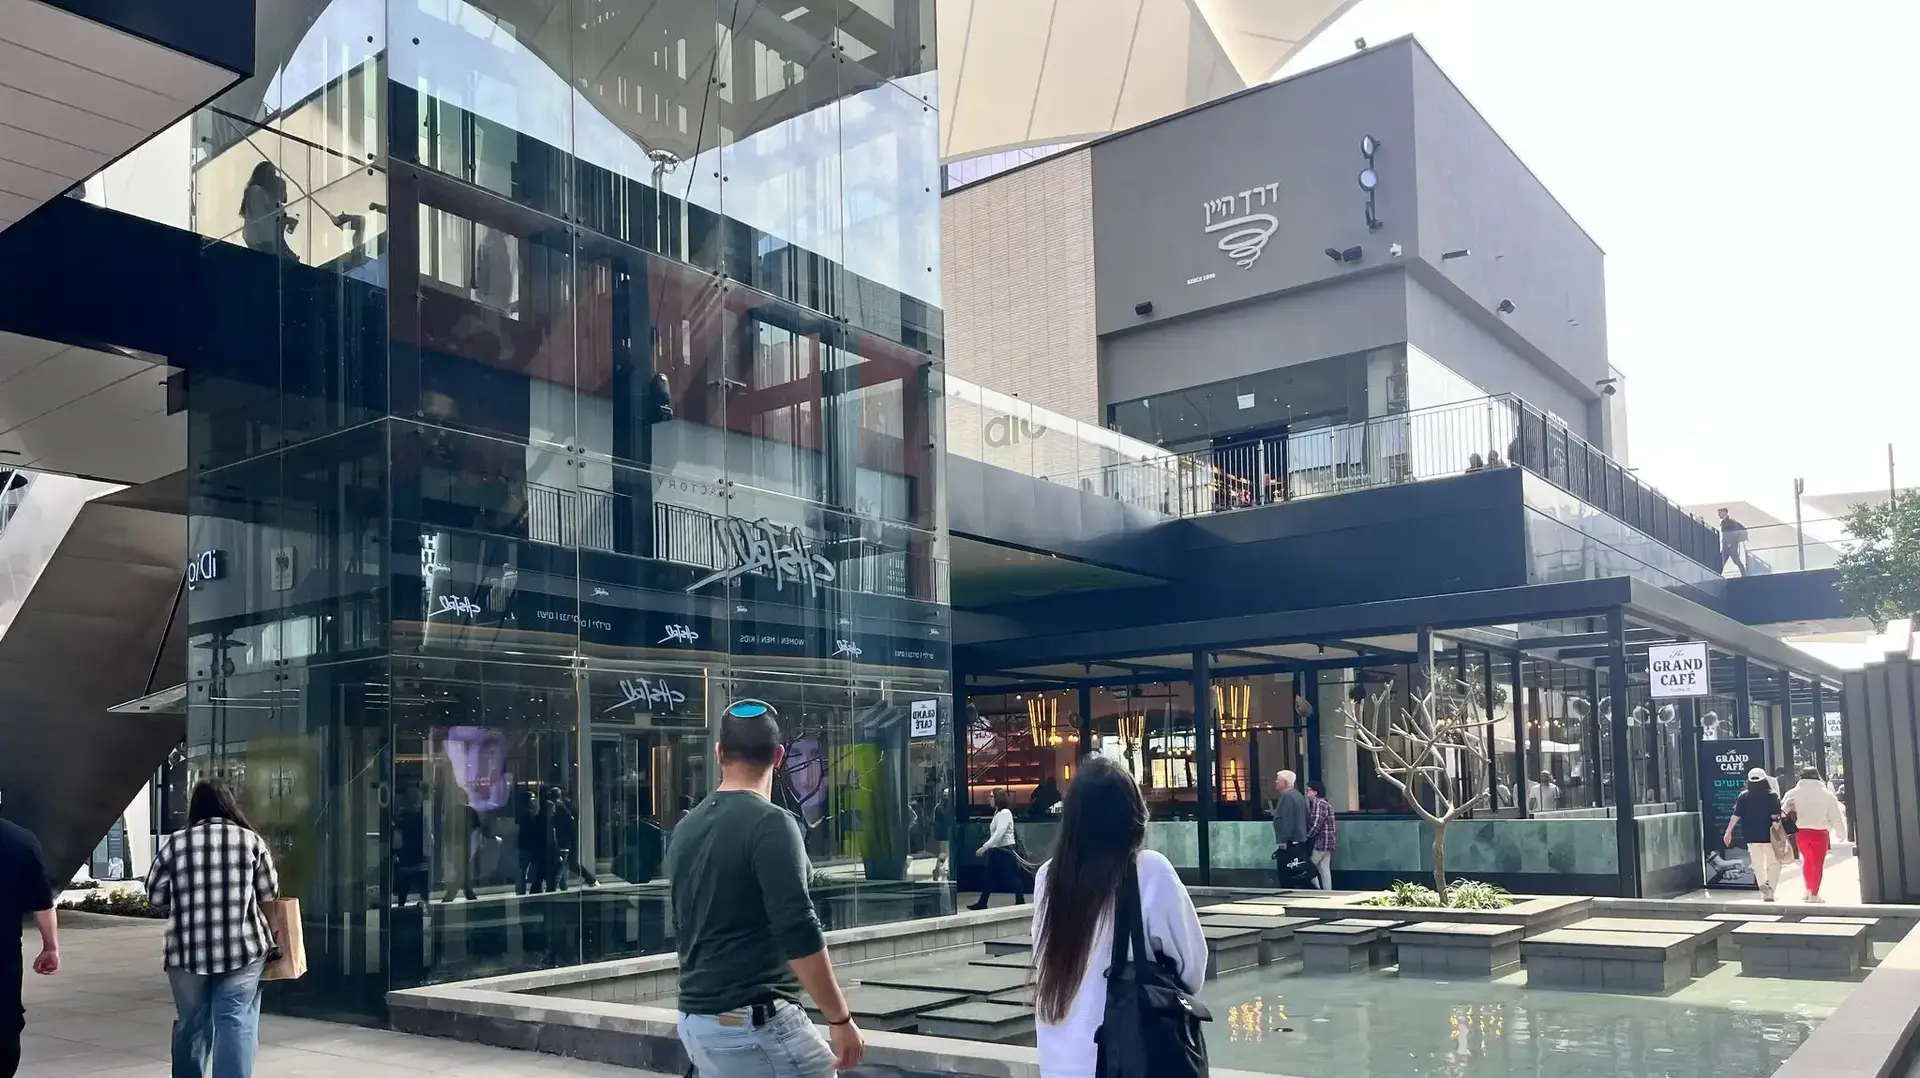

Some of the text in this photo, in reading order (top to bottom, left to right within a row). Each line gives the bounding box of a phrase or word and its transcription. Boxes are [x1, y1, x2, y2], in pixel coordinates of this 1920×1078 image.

[1203, 182, 1279, 226] דרך היין
[1652, 658, 1703, 673] GRAND
[1660, 669, 1696, 686] CAFÉ
[1715, 754, 1749, 763] GRAND
[1720, 761, 1745, 771] CAFÉ
[1713, 779, 1747, 788] רושים
